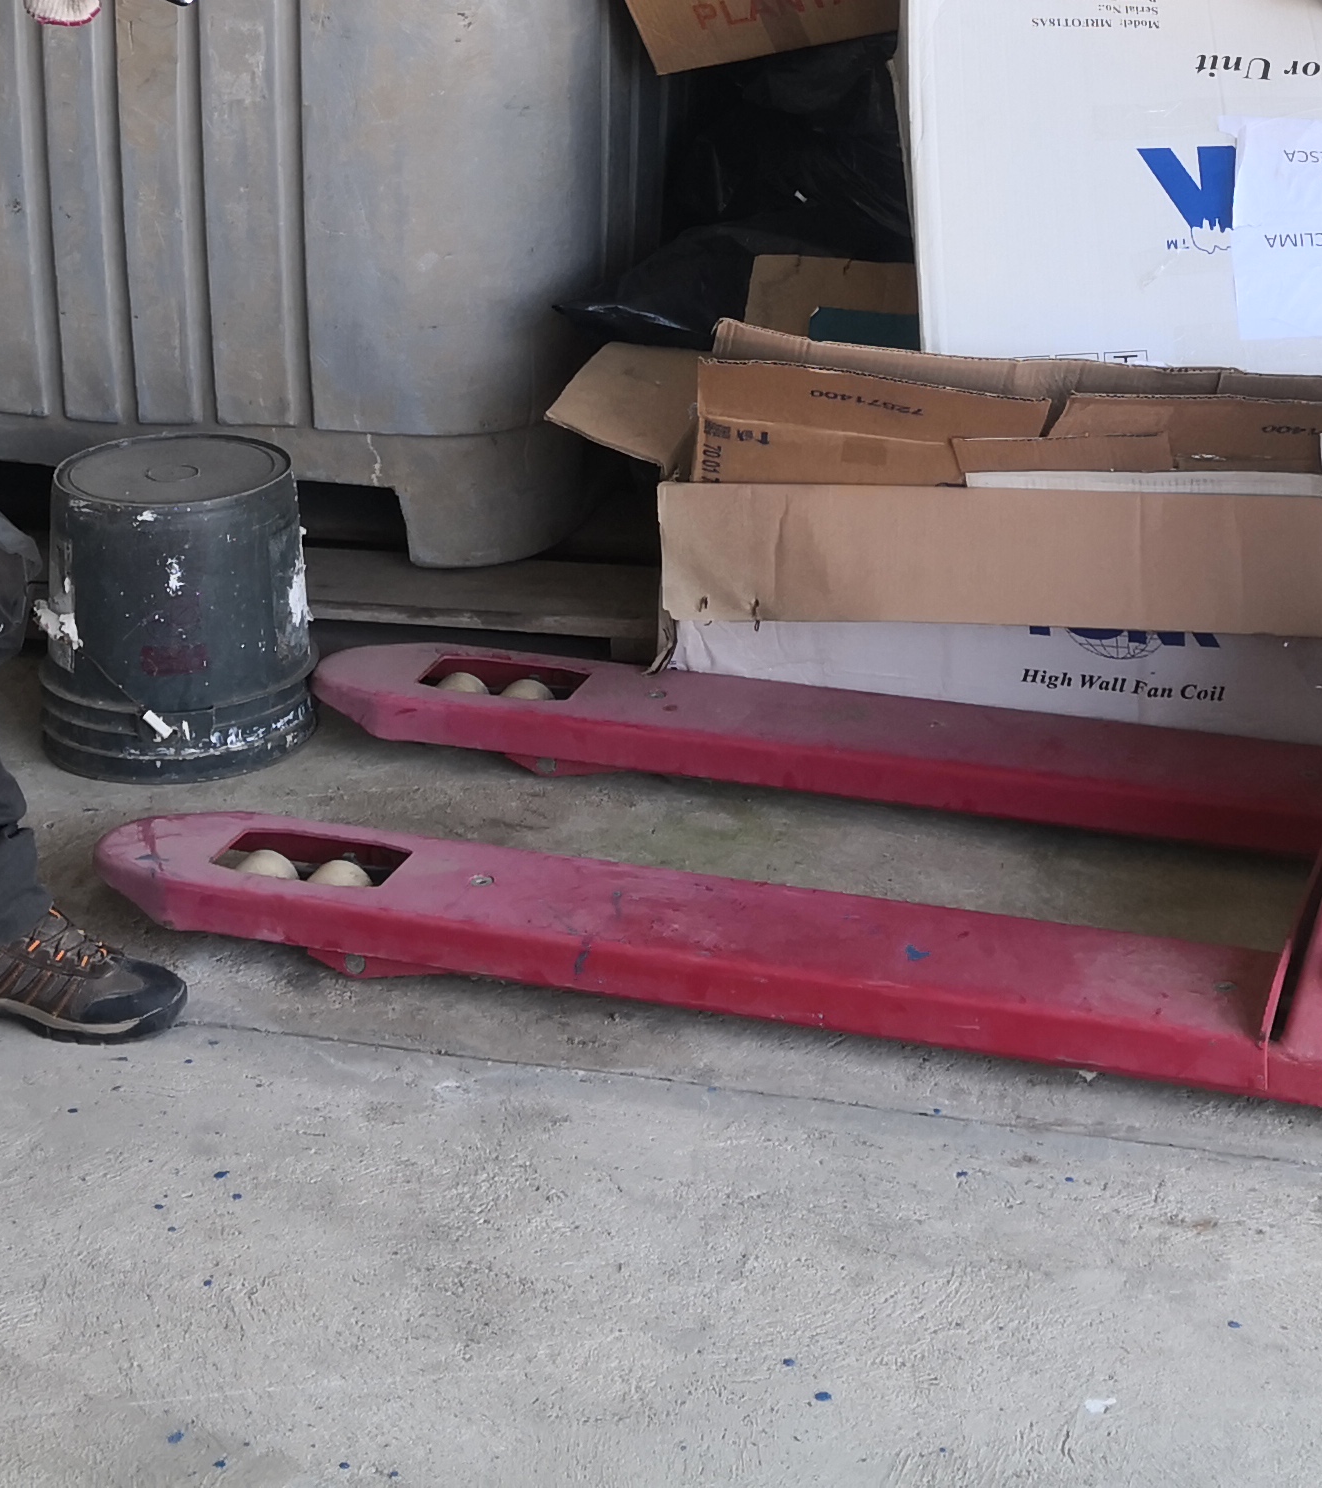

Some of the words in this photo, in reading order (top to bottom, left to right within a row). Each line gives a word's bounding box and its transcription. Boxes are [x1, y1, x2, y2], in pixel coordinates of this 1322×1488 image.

[1125, 5, 1159, 15] Serial
[1120, 18, 1161, 29] Model:
[1194, 53, 1272, 81] Unit
[1021, 668, 1073, 689] High
[1079, 673, 1126, 694] Wall
[1131, 680, 1173, 699] Fan
[1180, 683, 1226, 702] Coil
